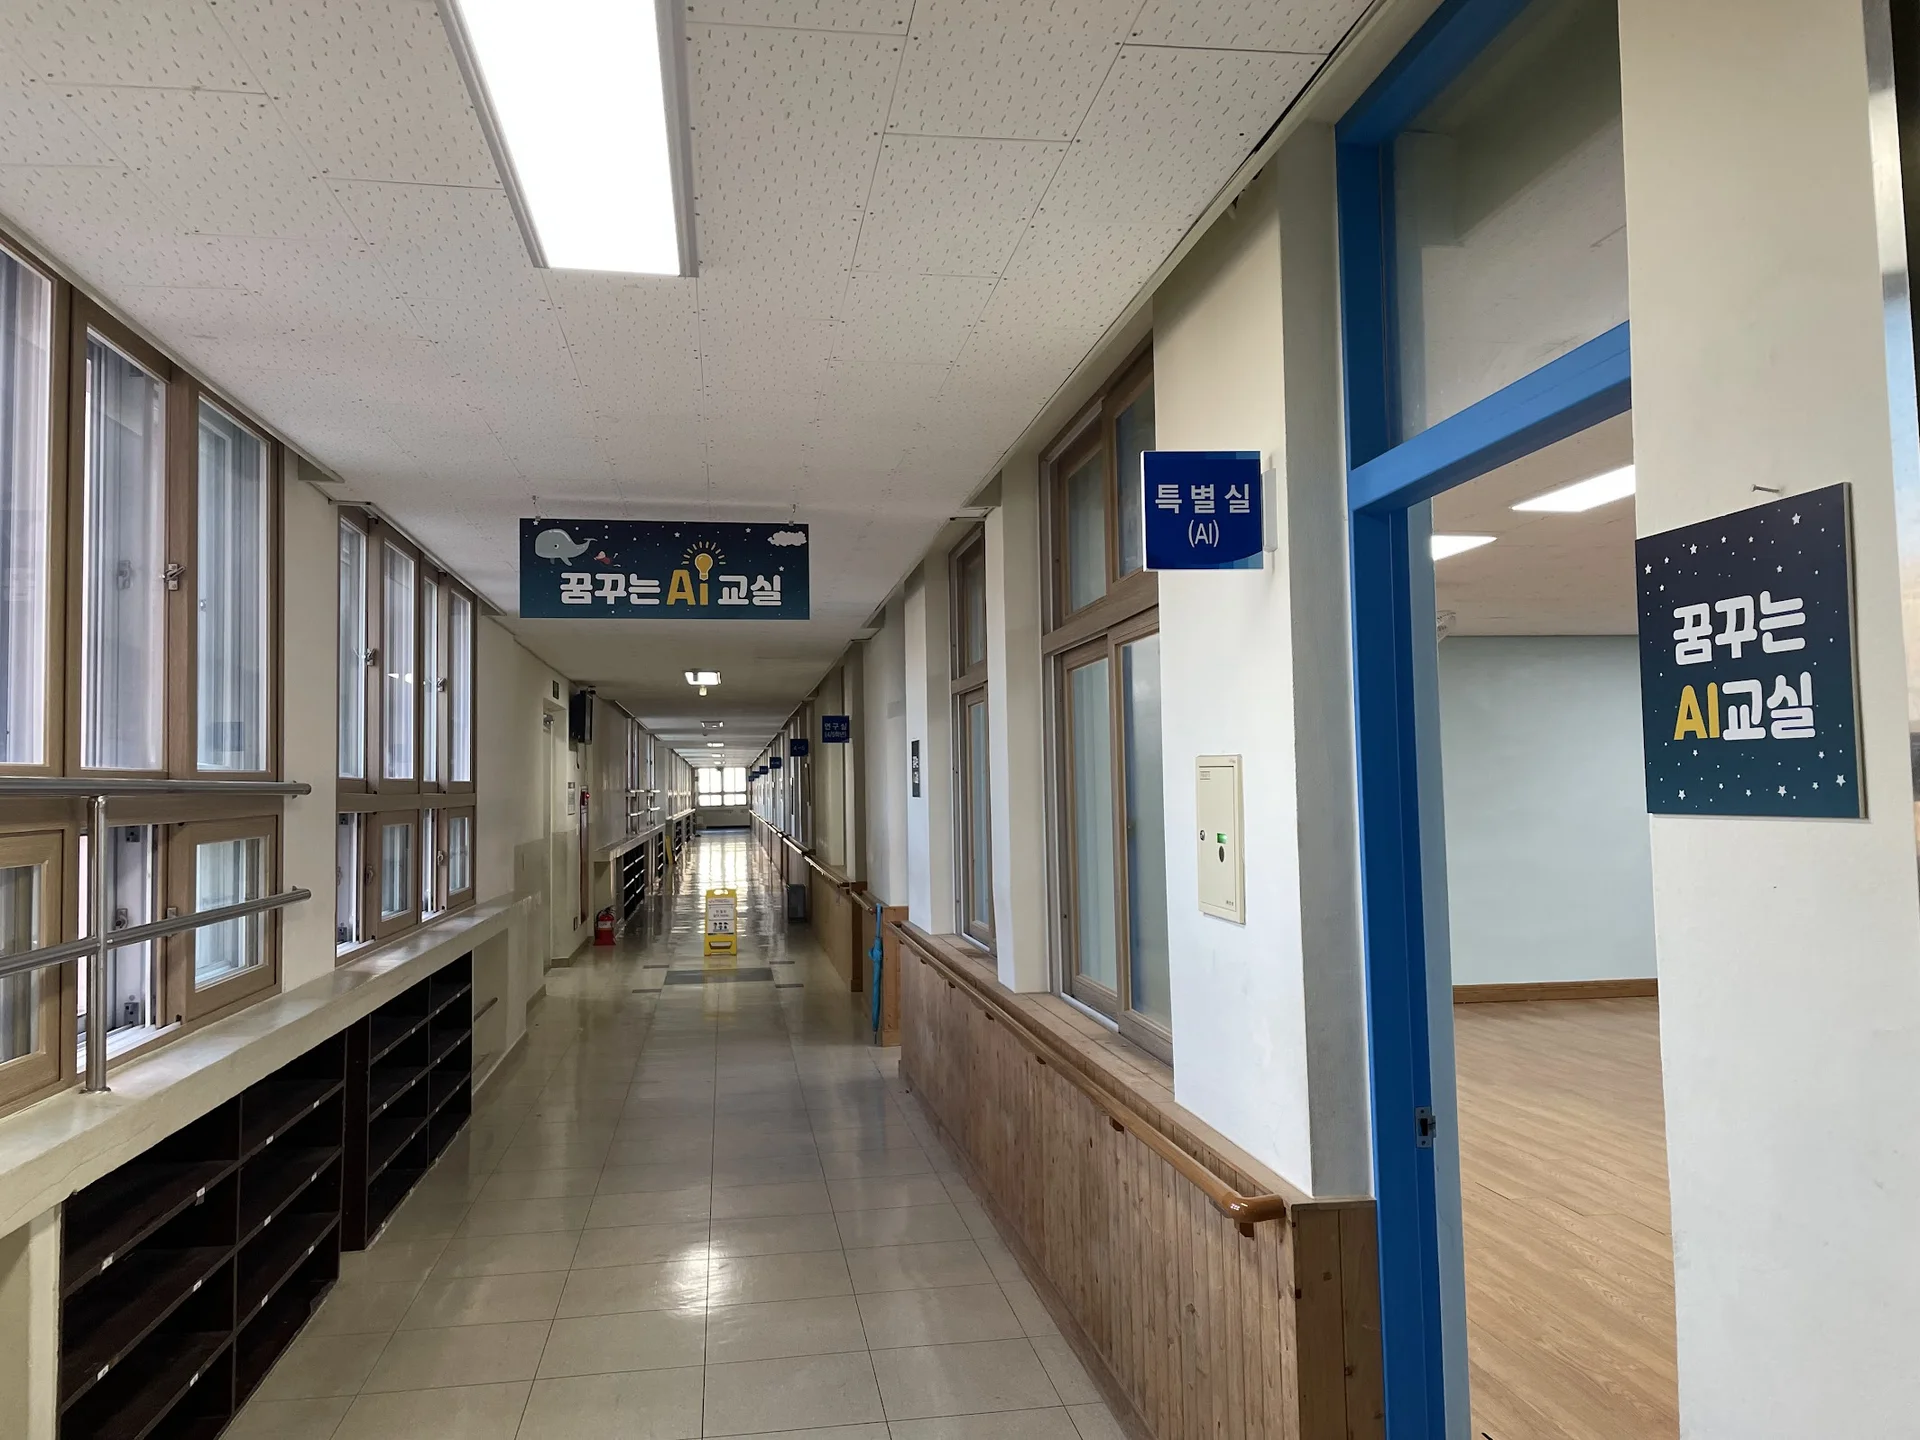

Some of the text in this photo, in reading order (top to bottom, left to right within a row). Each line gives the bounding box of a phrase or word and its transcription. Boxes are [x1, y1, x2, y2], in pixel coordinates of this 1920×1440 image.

[1188, 519, 1220, 548] (AI)
[560, 571, 661, 605] 꿈꾸는
[717, 574, 782, 606] 교실
[1672, 590, 1807, 666] 꿈꾸는
